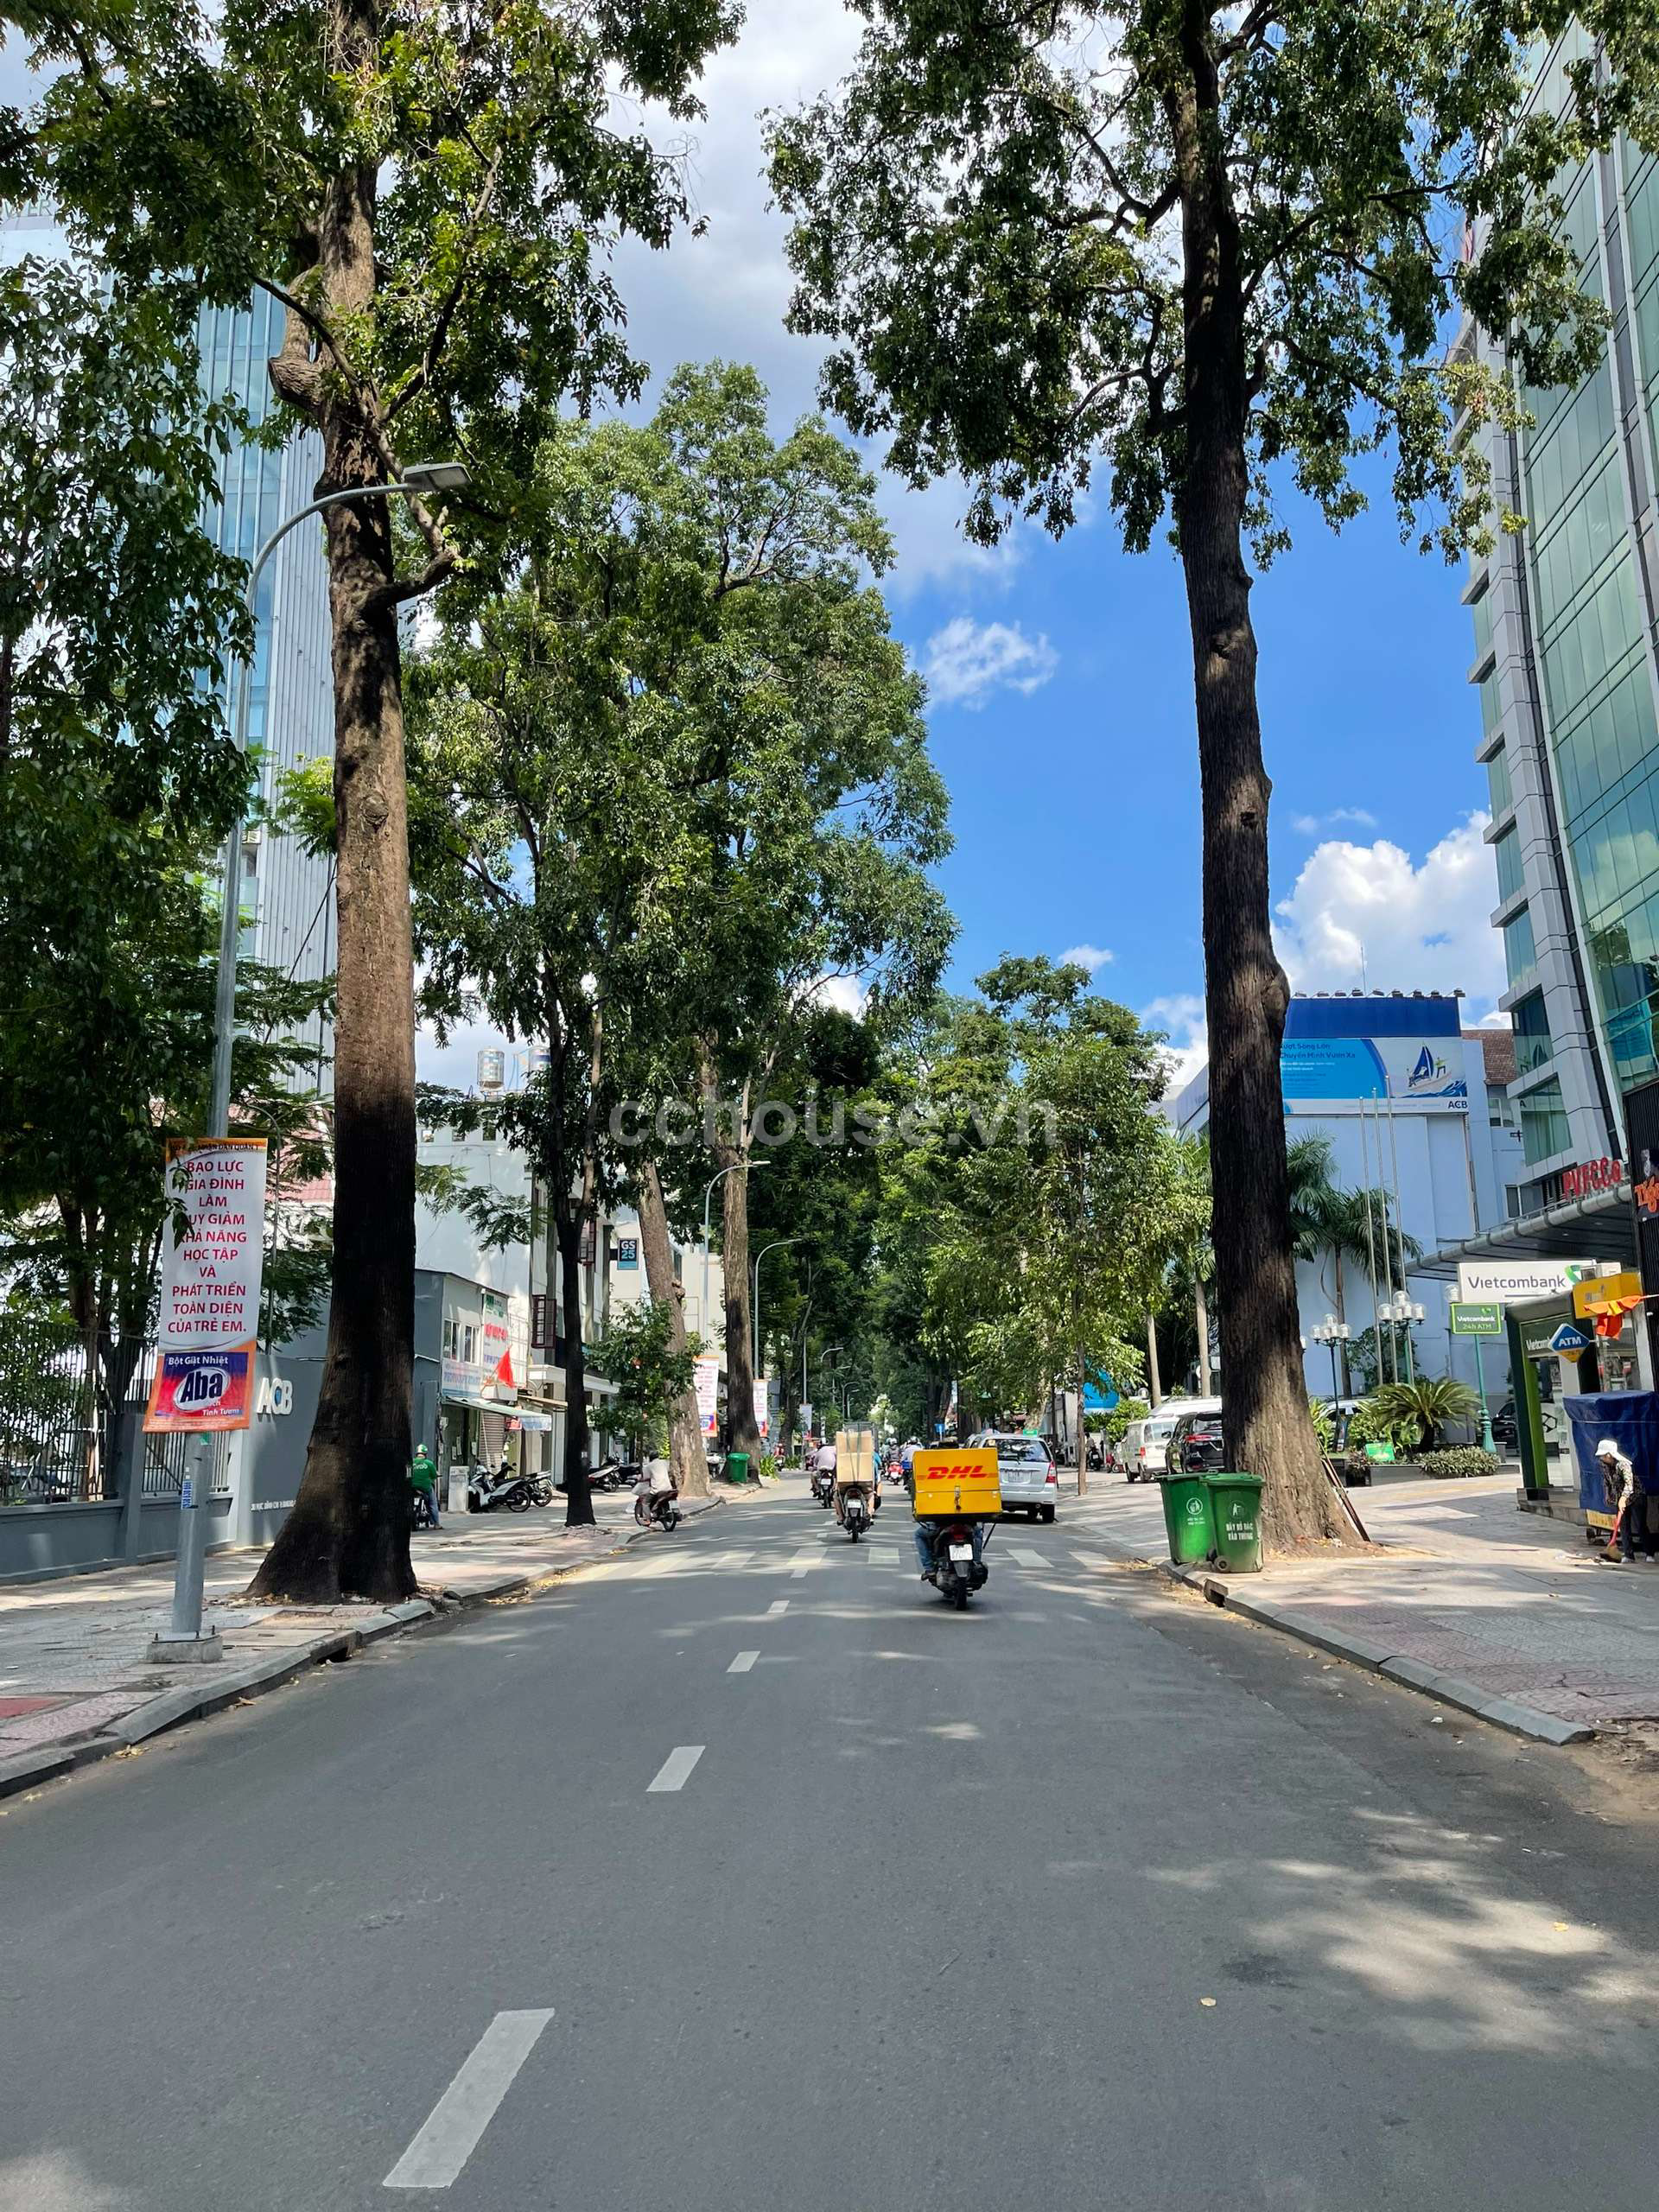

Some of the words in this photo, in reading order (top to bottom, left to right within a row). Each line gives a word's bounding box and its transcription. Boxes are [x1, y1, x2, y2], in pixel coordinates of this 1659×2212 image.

[1447, 1100, 1468, 1109] ACB
[187, 1161, 213, 1175] BẠO
[218, 1160, 244, 1175] LỰC
[188, 1179, 206, 1190] GIA
[210, 1177, 245, 1190] ĐÌNH
[199, 1194, 227, 1207] LÀM
[188, 1214, 205, 1225] UY
[208, 1211, 245, 1225] GIẢM
[206, 1230, 247, 1243] NĂNG
[620, 1240, 636, 1250] GS
[183, 1249, 209, 1262] HỌC
[212, 1247, 238, 1263] TẬP
[621, 1249, 636, 1260] 25
[200, 1264, 216, 1278] VÀ
[173, 1283, 203, 1297] PHÁT
[206, 1281, 246, 1296] TRIỂN
[1467, 1275, 1566, 1290] Vietcombank
[173, 1301, 206, 1315] TOÀN
[209, 1300, 243, 1317] DIỆN
[168, 1318, 192, 1333] CỦA
[194, 1318, 218, 1332] TRẺ
[221, 1320, 247, 1332] EM.
[1558, 1336, 1582, 1347] ATM
[168, 1357, 183, 1367] Bột
[202, 1355, 229, 1366] Nhiệt
[180, 1370, 224, 1403] Aba
[257, 1377, 293, 1415] ACB
[927, 1465, 988, 1479] DHL
